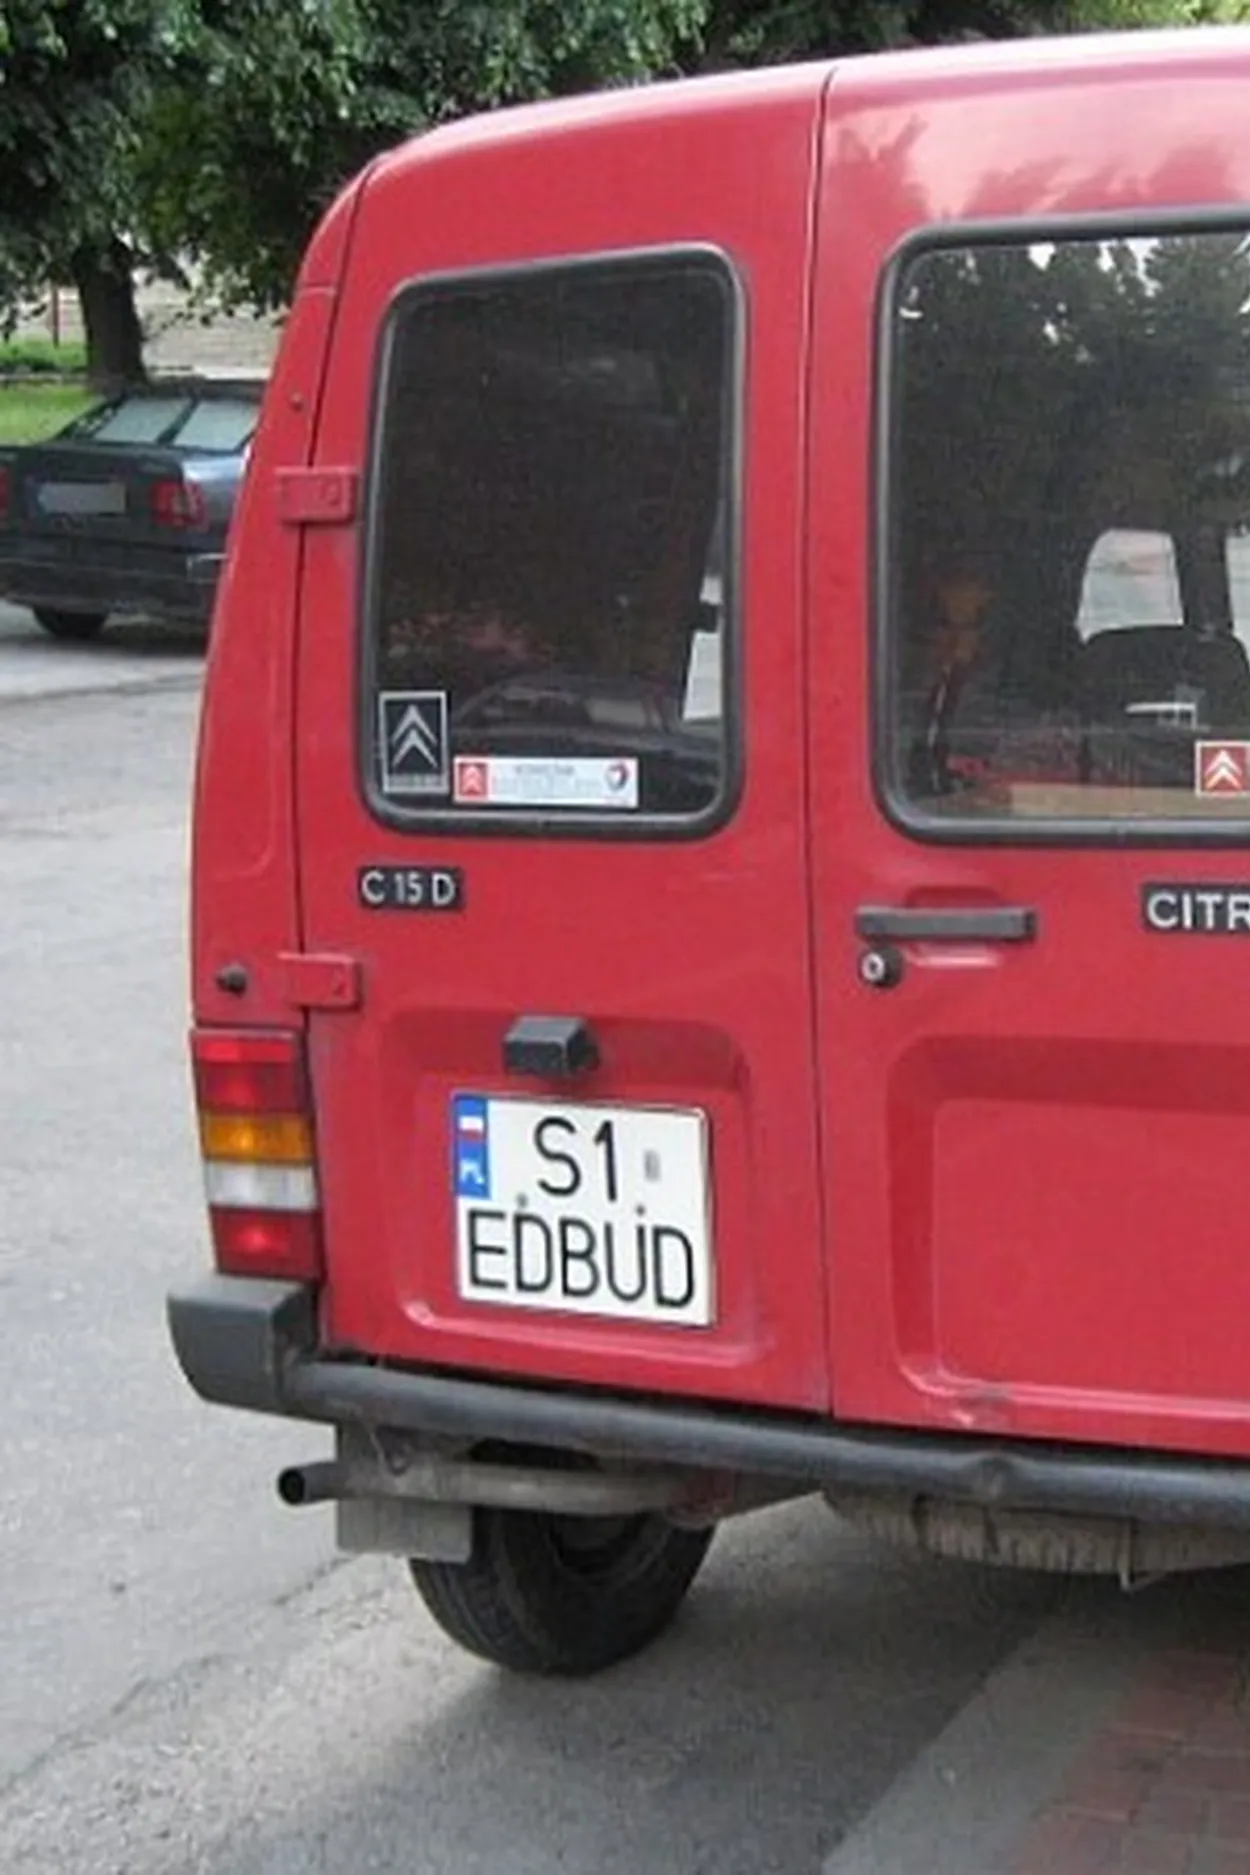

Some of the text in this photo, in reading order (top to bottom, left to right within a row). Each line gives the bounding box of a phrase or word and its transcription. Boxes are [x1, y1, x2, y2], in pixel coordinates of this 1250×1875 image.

[361, 871, 456, 906] C 15 D
[533, 1116, 617, 1202] S1
[467, 1209, 695, 1309] EDBUD
